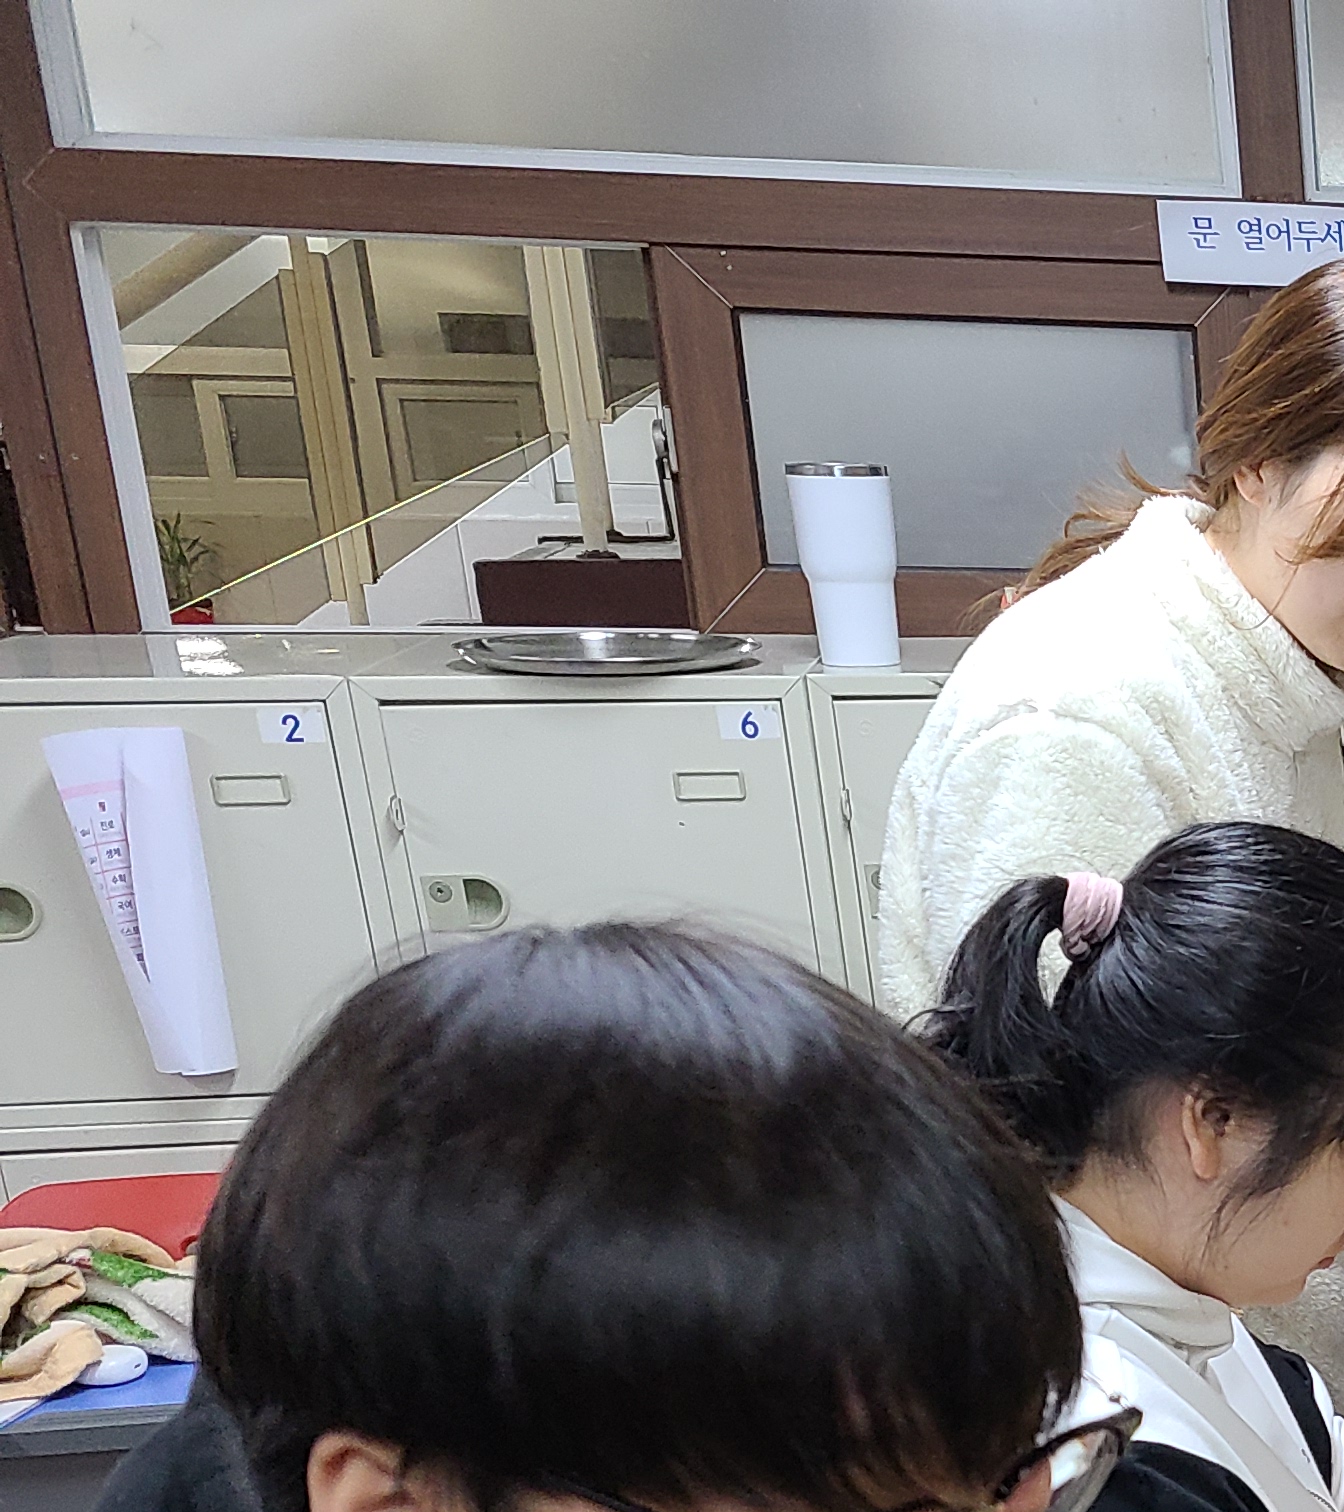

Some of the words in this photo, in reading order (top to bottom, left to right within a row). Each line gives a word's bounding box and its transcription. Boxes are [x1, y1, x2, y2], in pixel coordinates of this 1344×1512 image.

[1187, 216, 1221, 250] 문
[281, 713, 305, 743] 2
[740, 710, 760, 739] 6
